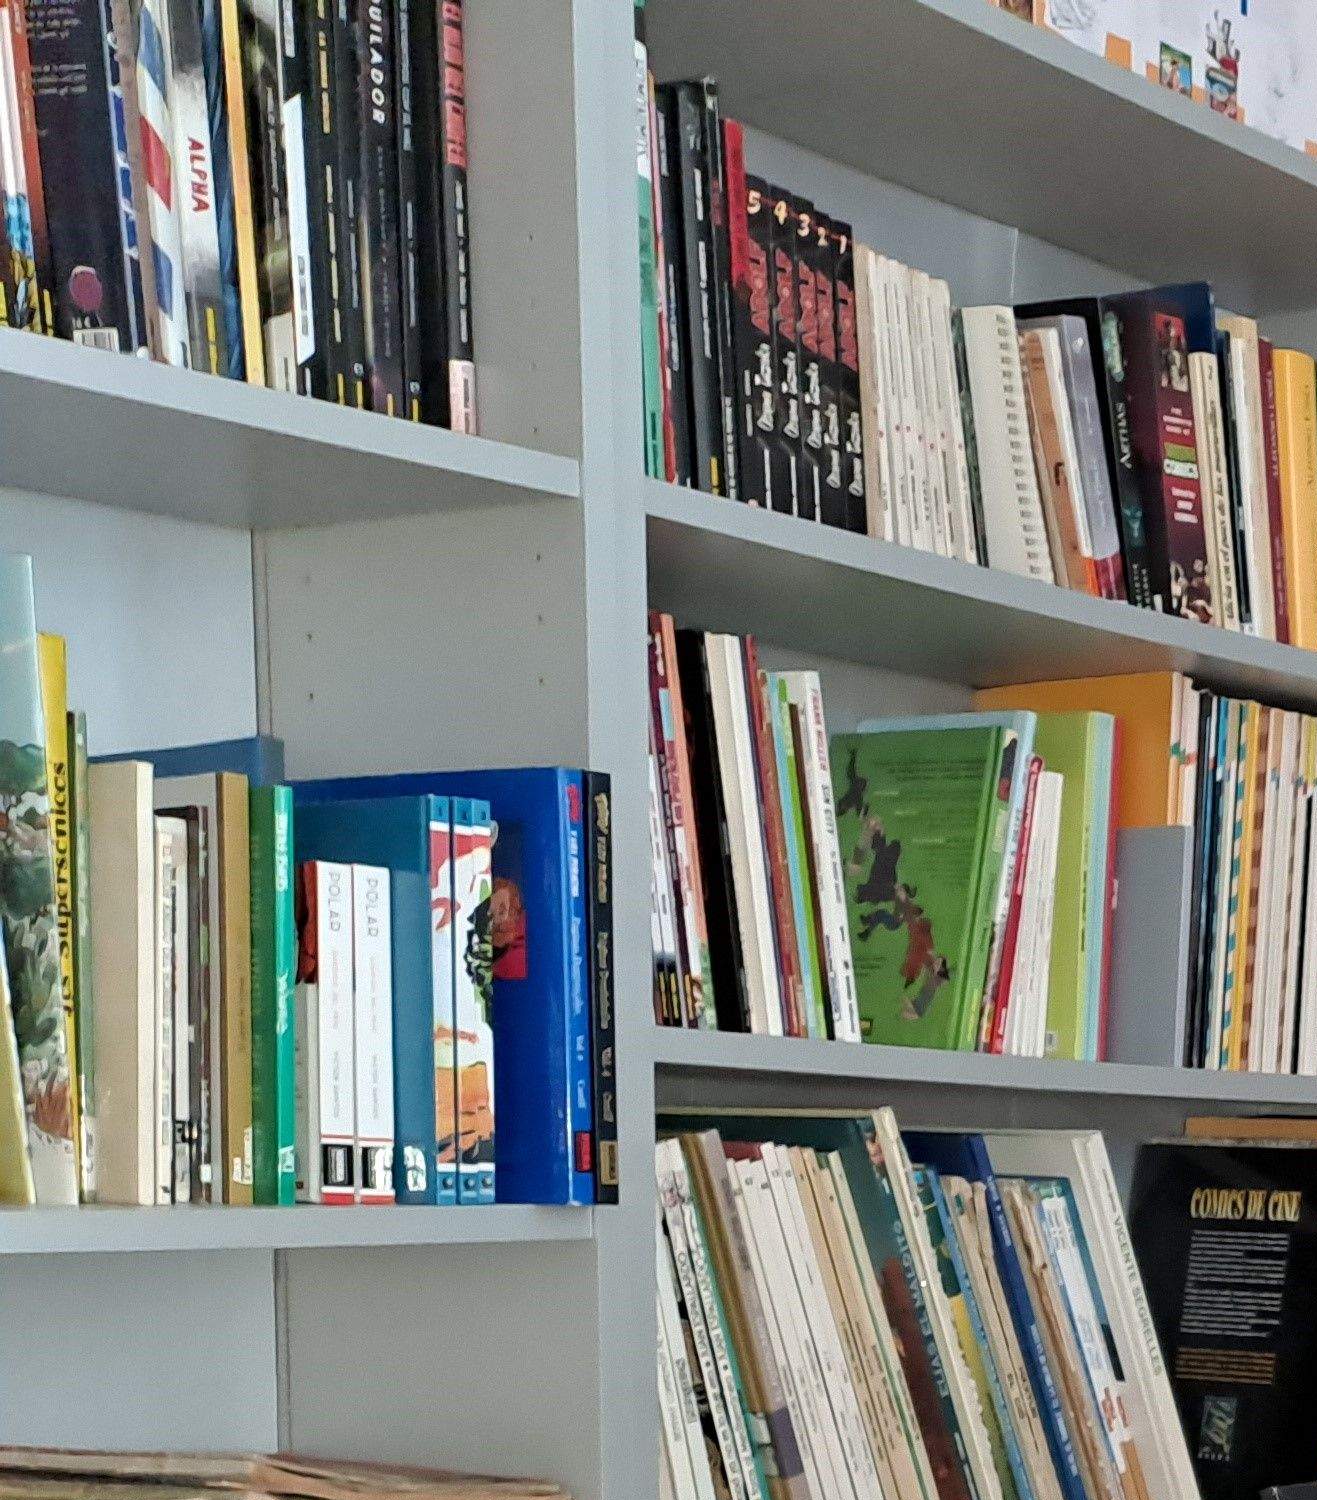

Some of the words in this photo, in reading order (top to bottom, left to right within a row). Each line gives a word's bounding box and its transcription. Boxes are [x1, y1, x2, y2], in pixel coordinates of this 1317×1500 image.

[187, 137, 210, 213] ALPHA
[748, 191, 761, 212] 5
[774, 201, 787, 224] 4
[797, 213, 811, 237] 3
[1189, 1187, 1245, 1221] COMICS
[1246, 1190, 1266, 1222] DE
[1268, 1190, 1303, 1222] CINE
[1114, 1215, 1137, 1277] VICENTE
[1135, 1278, 1164, 1377] SEGRELLES
